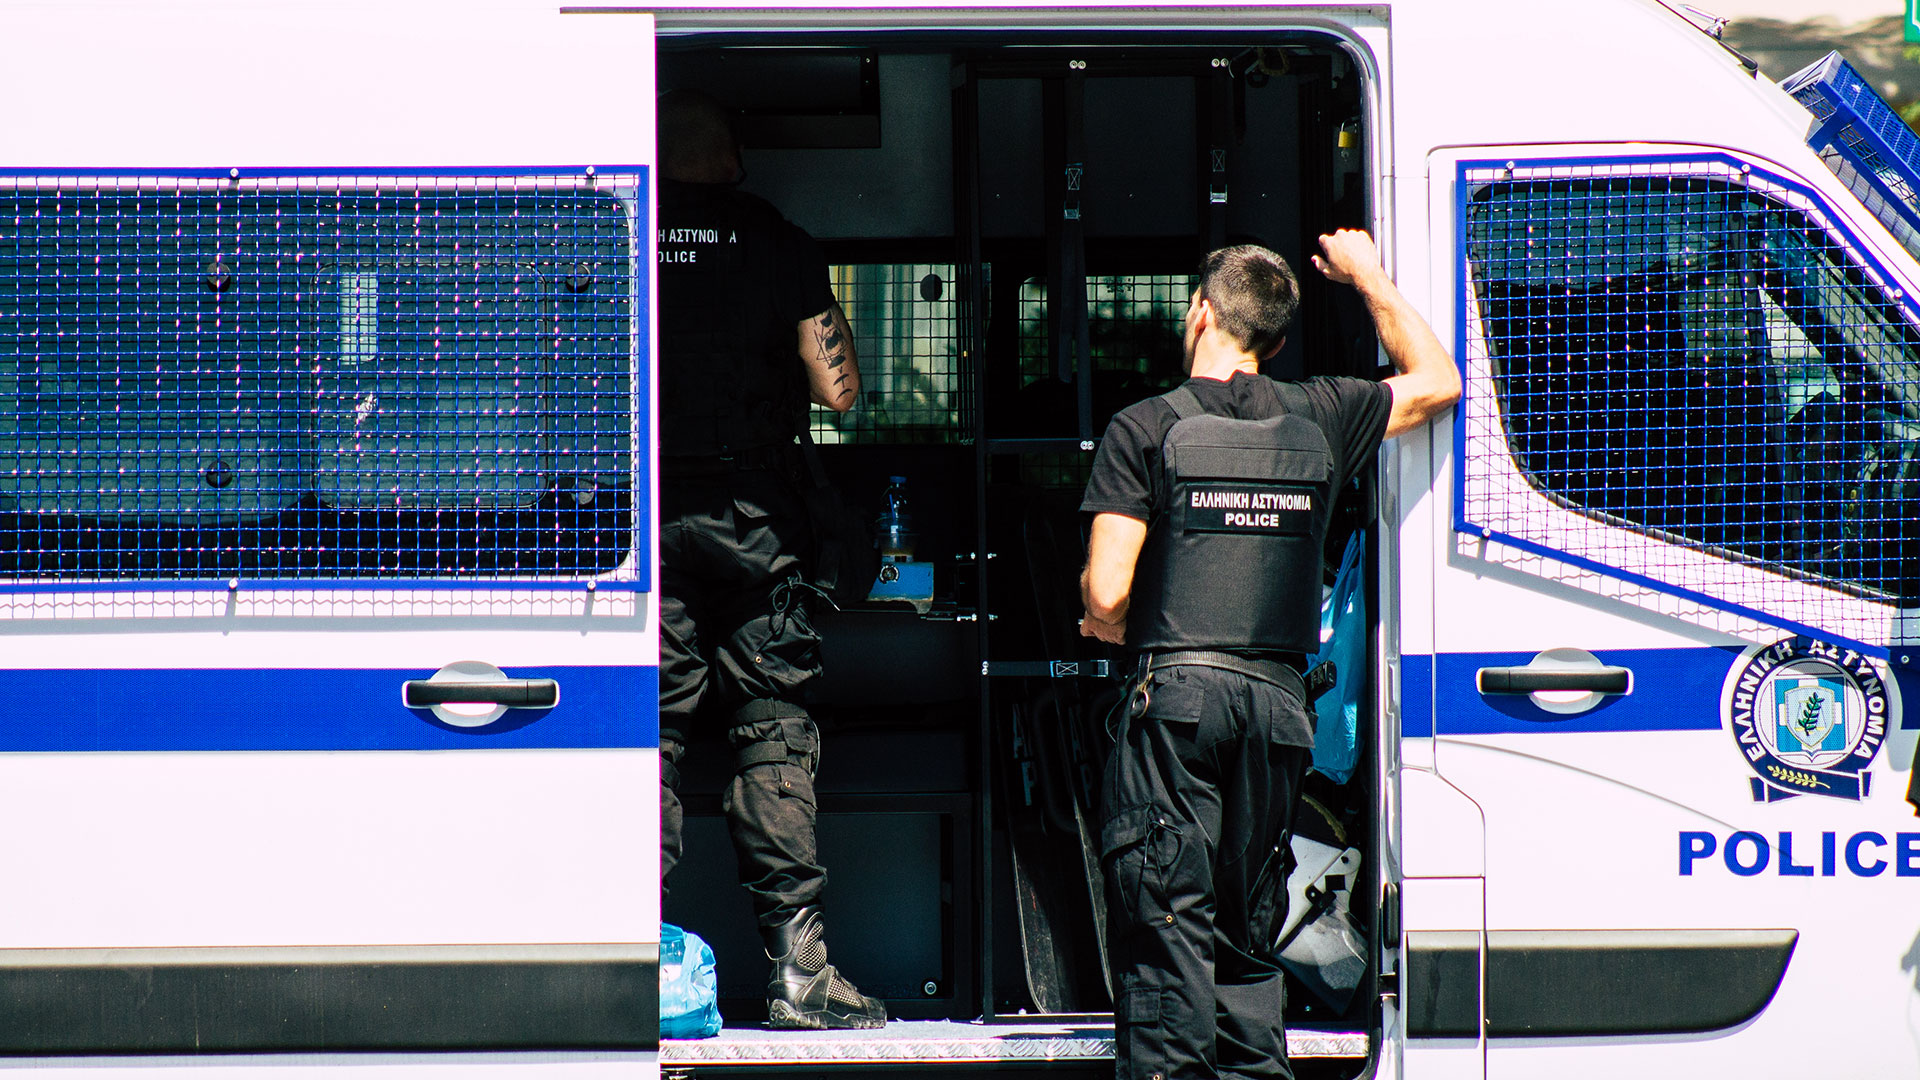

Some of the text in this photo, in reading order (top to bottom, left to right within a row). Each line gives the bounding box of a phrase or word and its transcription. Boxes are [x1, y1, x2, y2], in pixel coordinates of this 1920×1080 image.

[669, 229, 737, 243] ΑΣΤΥΝΟΑ
[1191, 492, 1312, 510] ΕΛΛΗΝΙΚΗ ΑΣΤΥΝΟΜΙΑ
[1225, 512, 1280, 527] POLICE
[1734, 640, 1794, 762] ΕΛΛΗΝΙΚΗ
[1678, 830, 1920, 877] POLICE
